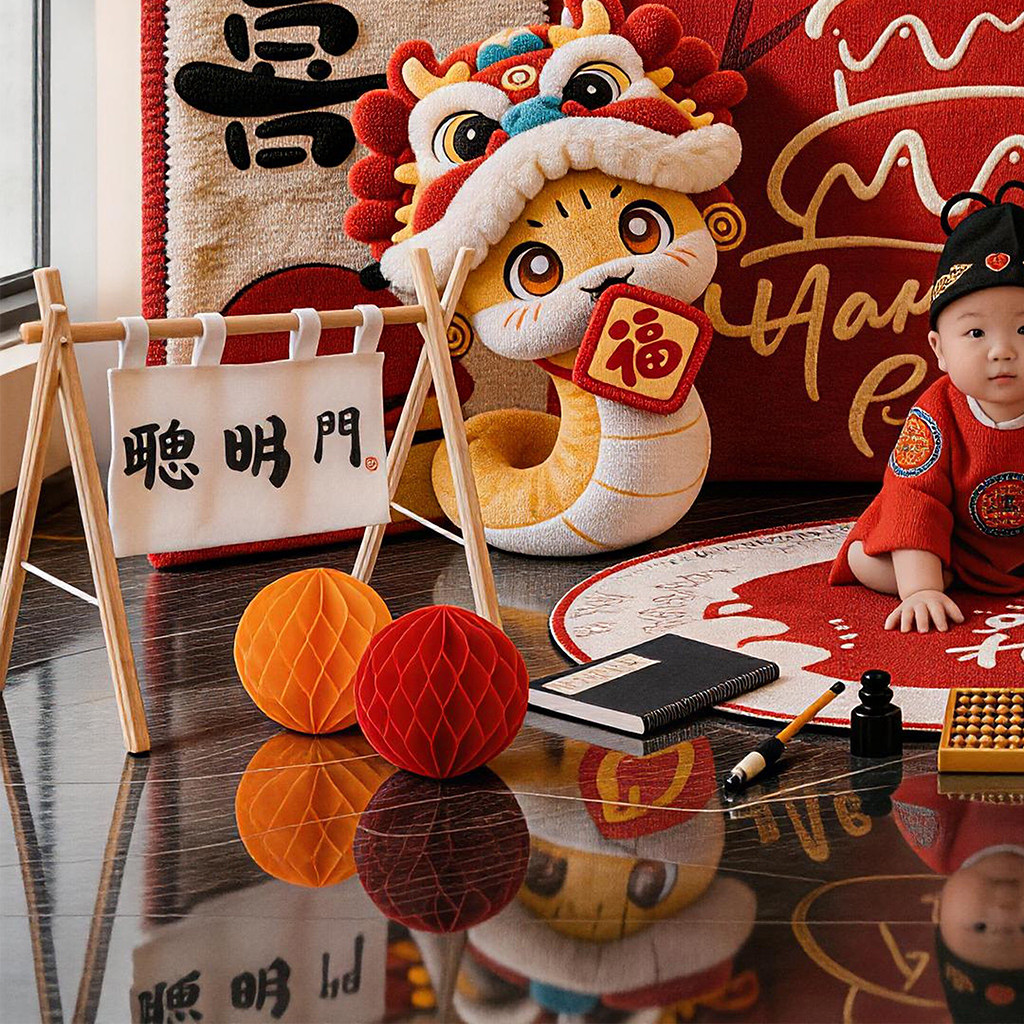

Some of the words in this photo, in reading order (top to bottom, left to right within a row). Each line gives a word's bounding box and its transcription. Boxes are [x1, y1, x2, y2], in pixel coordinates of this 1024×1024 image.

[606, 307, 683, 388] 福
[123, 406, 362, 491] 聰明門
